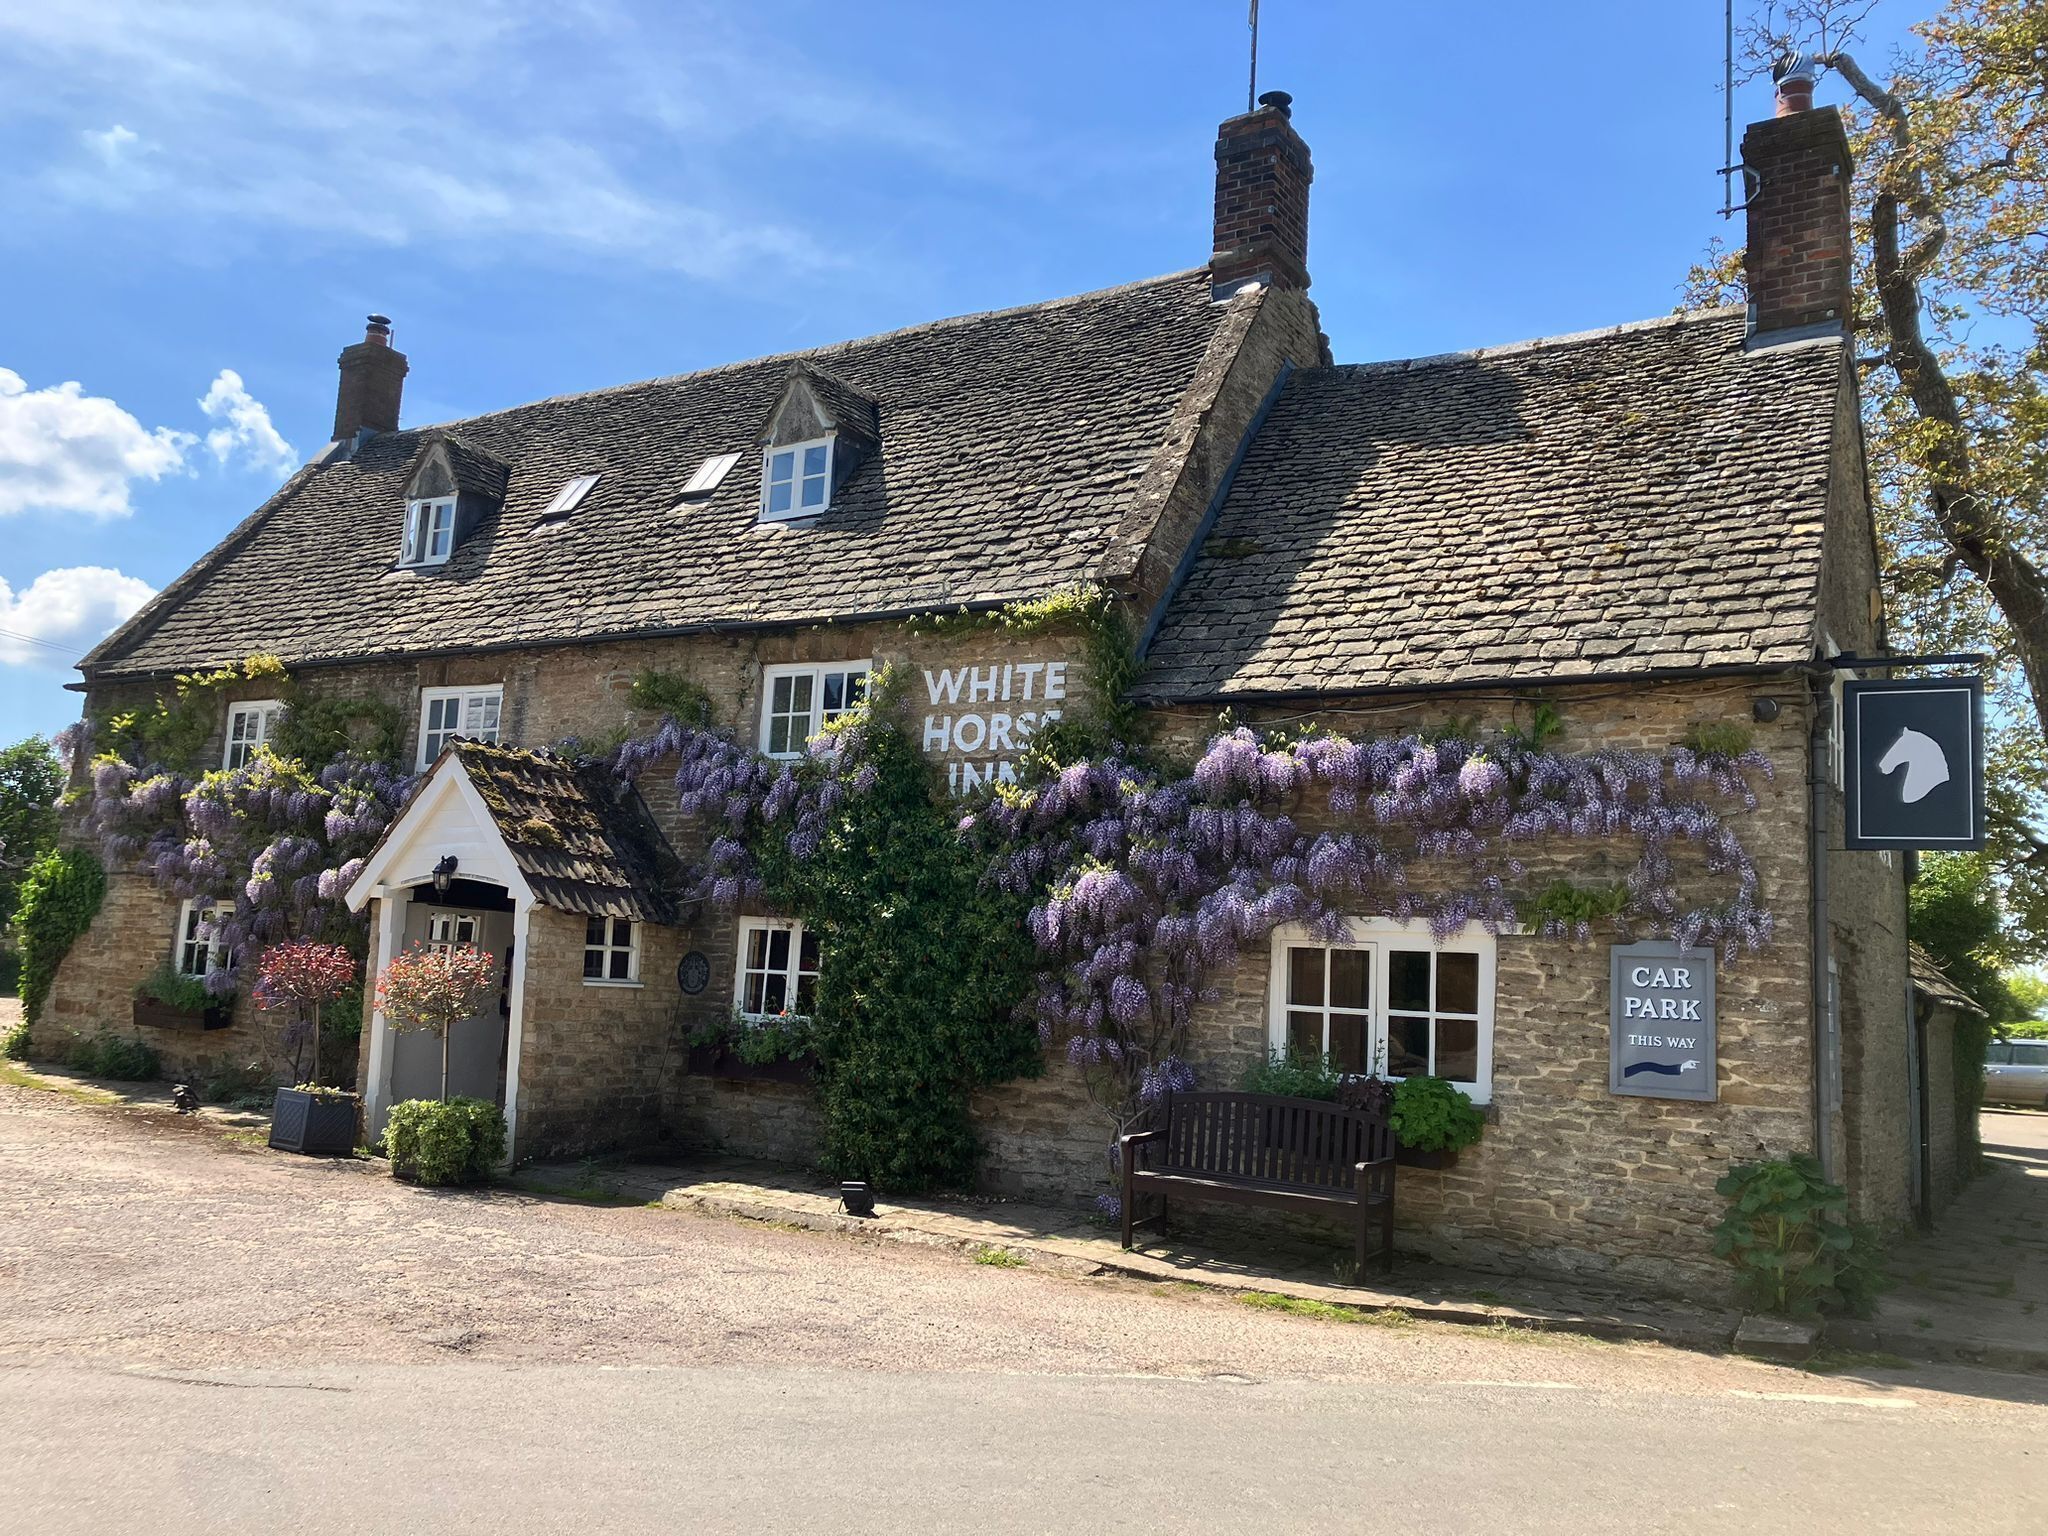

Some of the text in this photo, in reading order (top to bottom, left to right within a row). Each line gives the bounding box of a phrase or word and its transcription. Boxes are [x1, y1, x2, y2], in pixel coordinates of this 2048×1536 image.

[924, 661, 1068, 705] WHITE
[923, 709, 1063, 752] HORS
[1631, 966, 1692, 989] CAR
[1624, 996, 1701, 1021] PARK
[1628, 1034, 1696, 1049] THIS WAY
